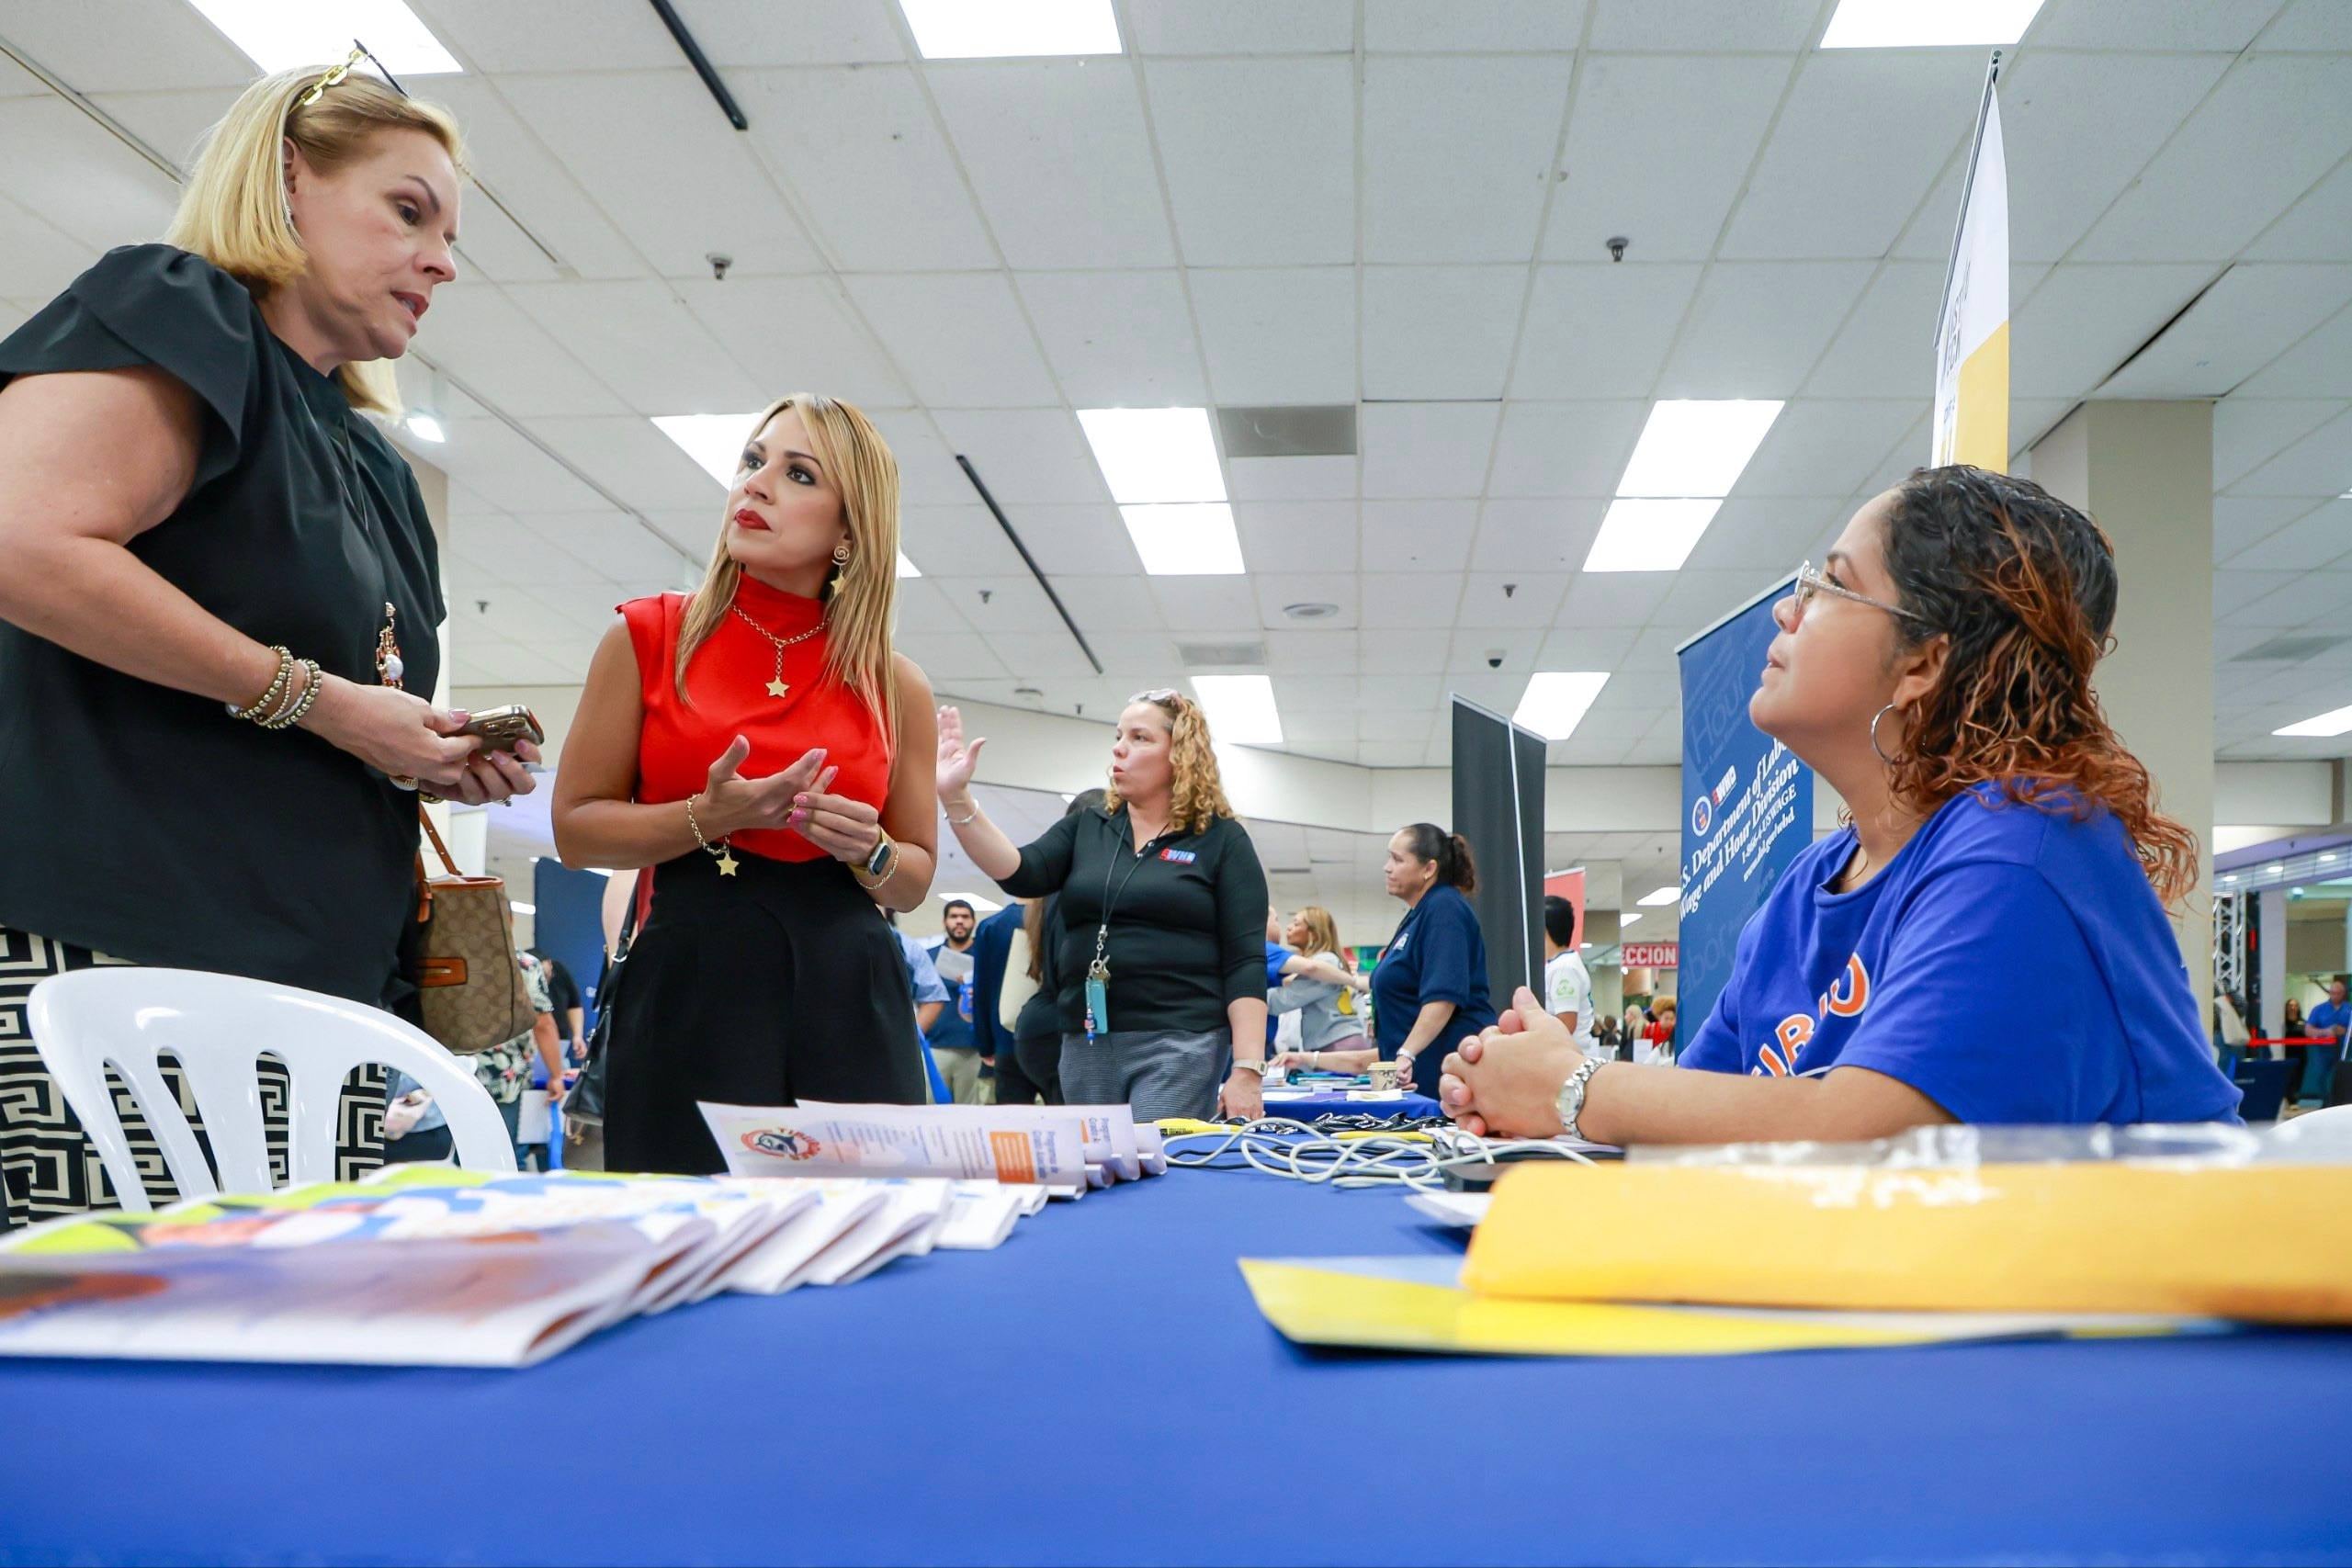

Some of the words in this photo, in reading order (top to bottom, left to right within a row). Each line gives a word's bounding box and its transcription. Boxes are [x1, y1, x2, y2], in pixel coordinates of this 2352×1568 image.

[1679, 885, 1702, 922] Wage
[1702, 848, 1724, 893] and
[1724, 820, 1751, 866] Hour
[1752, 758, 1800, 829] Division
[1691, 786, 1751, 877] Department
[1752, 760, 1762, 798] of
